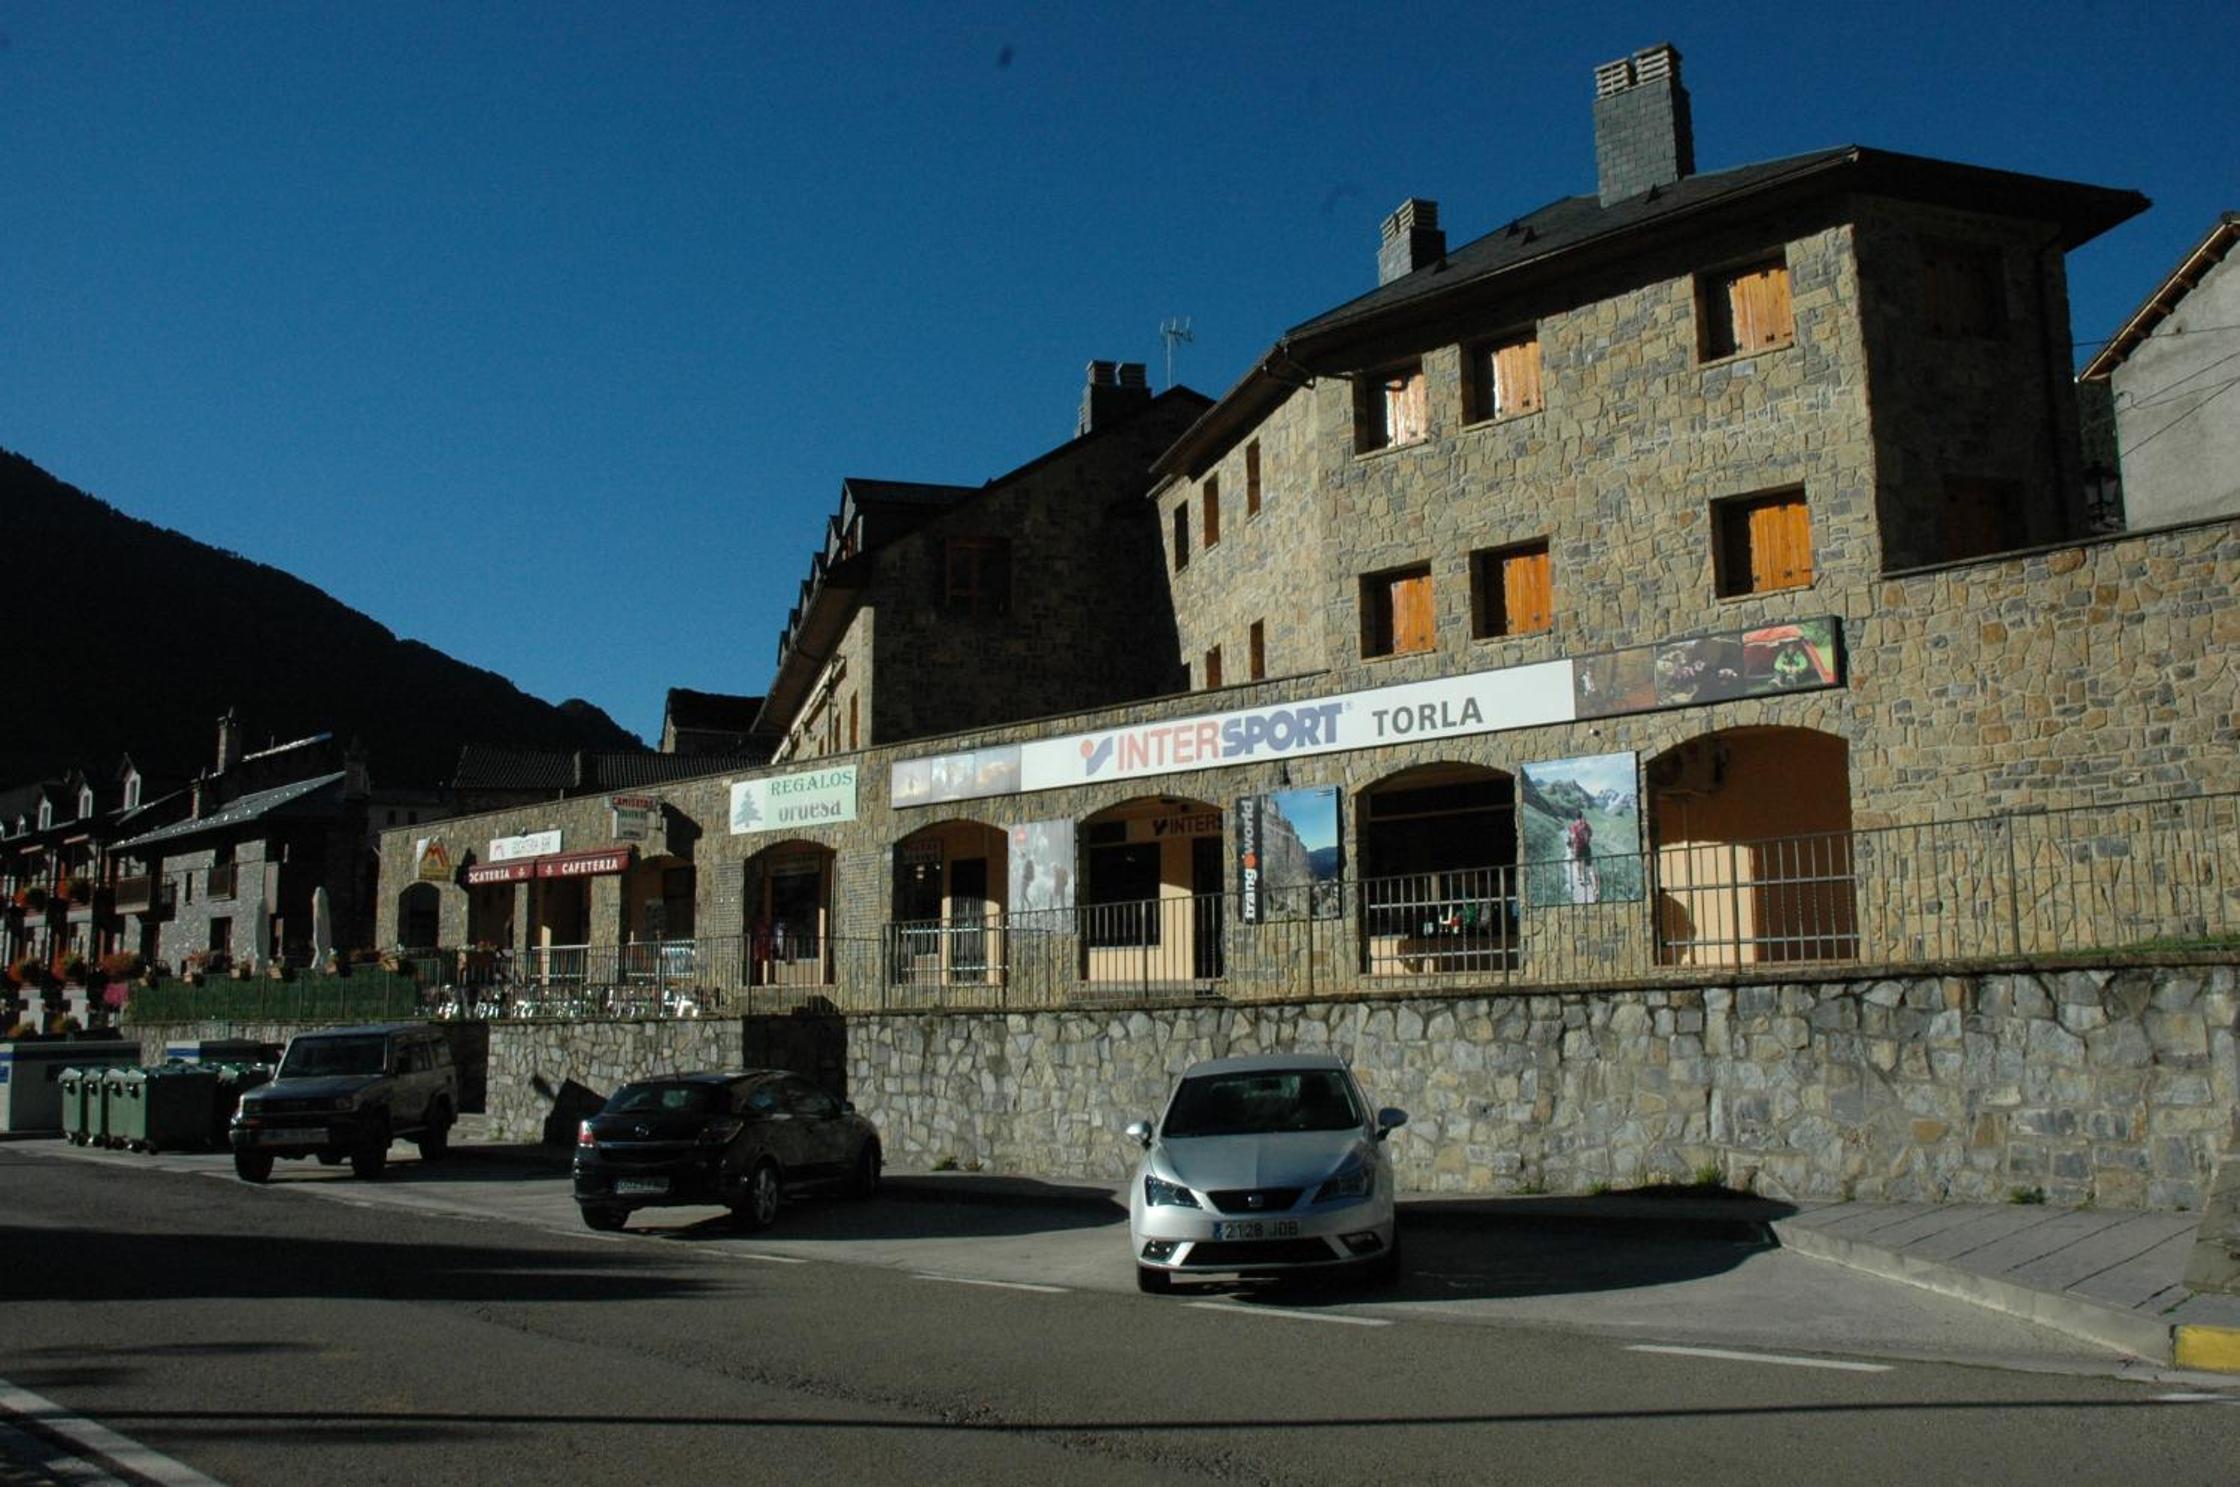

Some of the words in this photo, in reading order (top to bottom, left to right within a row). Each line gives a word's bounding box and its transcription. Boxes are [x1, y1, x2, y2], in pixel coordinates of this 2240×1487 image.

[1117, 703, 1342, 771] INTERSPORT
[1372, 697, 1483, 737] TORLA
[771, 771, 853, 796] REGALOS
[561, 858, 618, 874] CAFETERIA
